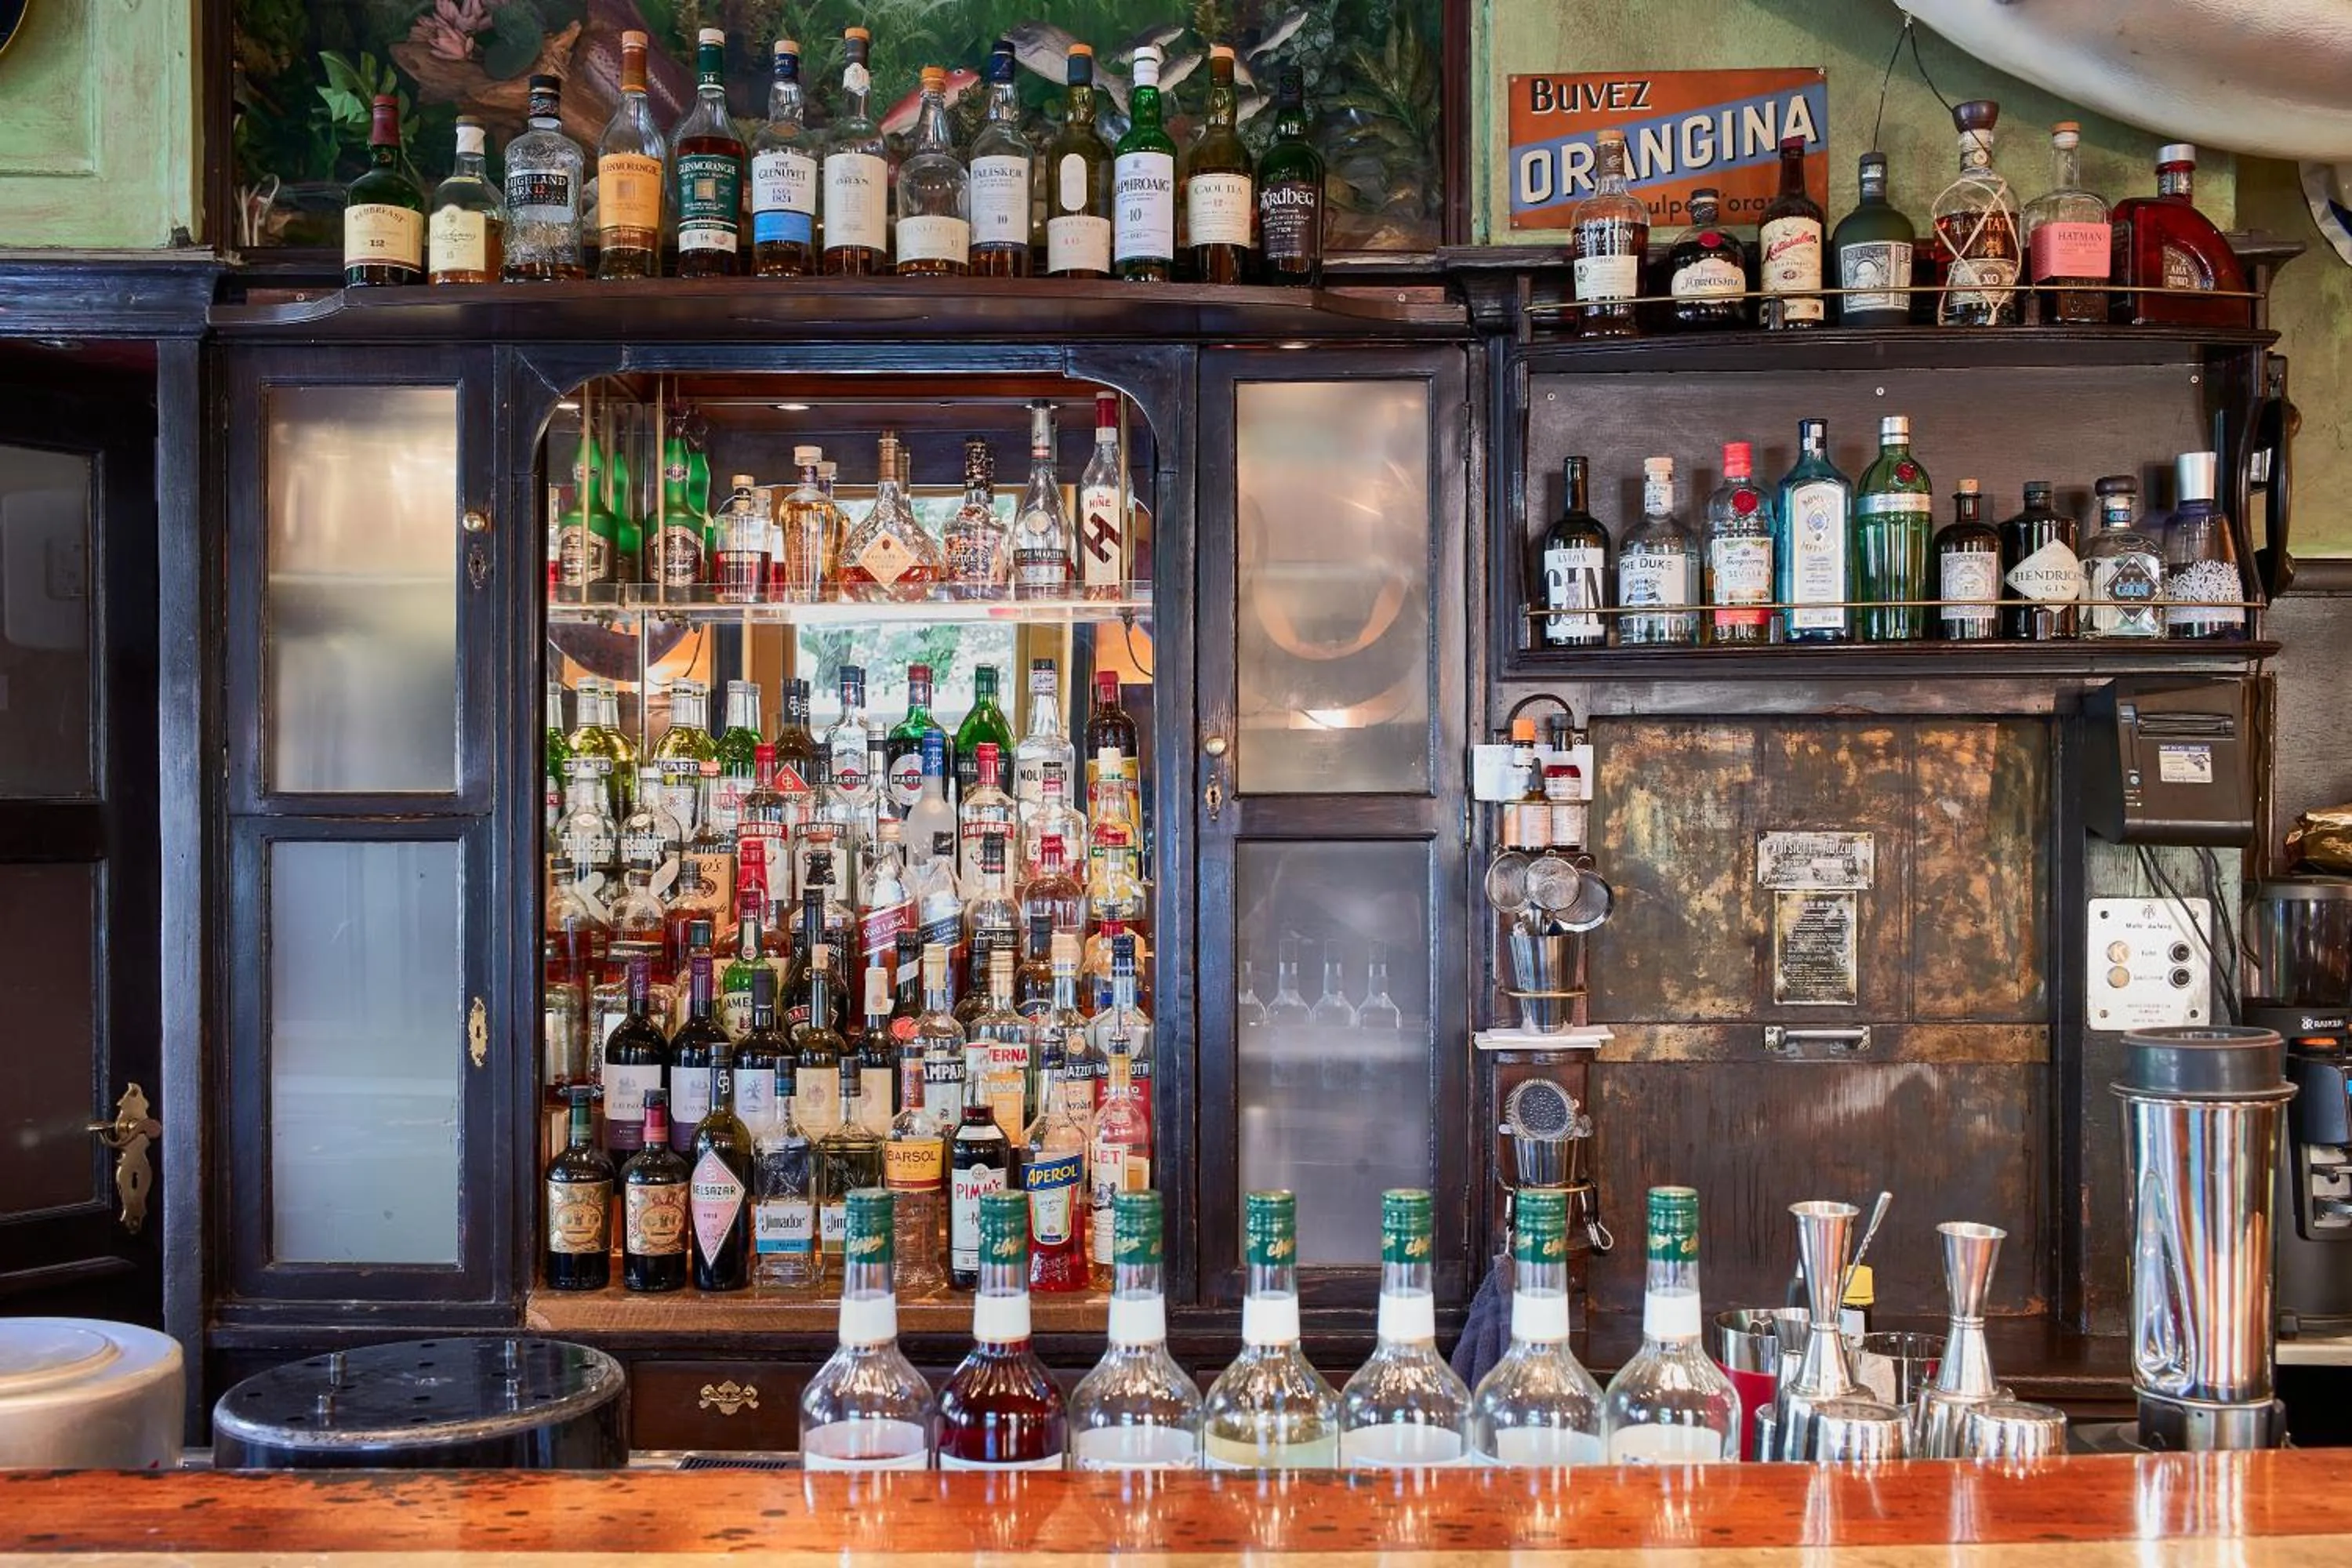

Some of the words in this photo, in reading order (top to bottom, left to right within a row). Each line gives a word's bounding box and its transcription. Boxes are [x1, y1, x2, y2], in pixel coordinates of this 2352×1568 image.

[677, 160, 736, 175] GLENMORANGIE
[973, 167, 1023, 179] TALISKER
[758, 169, 806, 181] GLENLIVET
[534, 185, 545, 195] 12
[353, 206, 405, 223] REDBREAST
[996, 215, 1008, 225] 10
[1129, 207, 1142, 223] 10
[1982, 273, 1999, 285] XO
[1089, 499, 1112, 509] HINE
[1639, 557, 1673, 571] DUKE
[1546, 567, 1604, 626] GIN
[887, 1149, 937, 1163] BARSOL
[1028, 1164, 1078, 1186] APEROL
